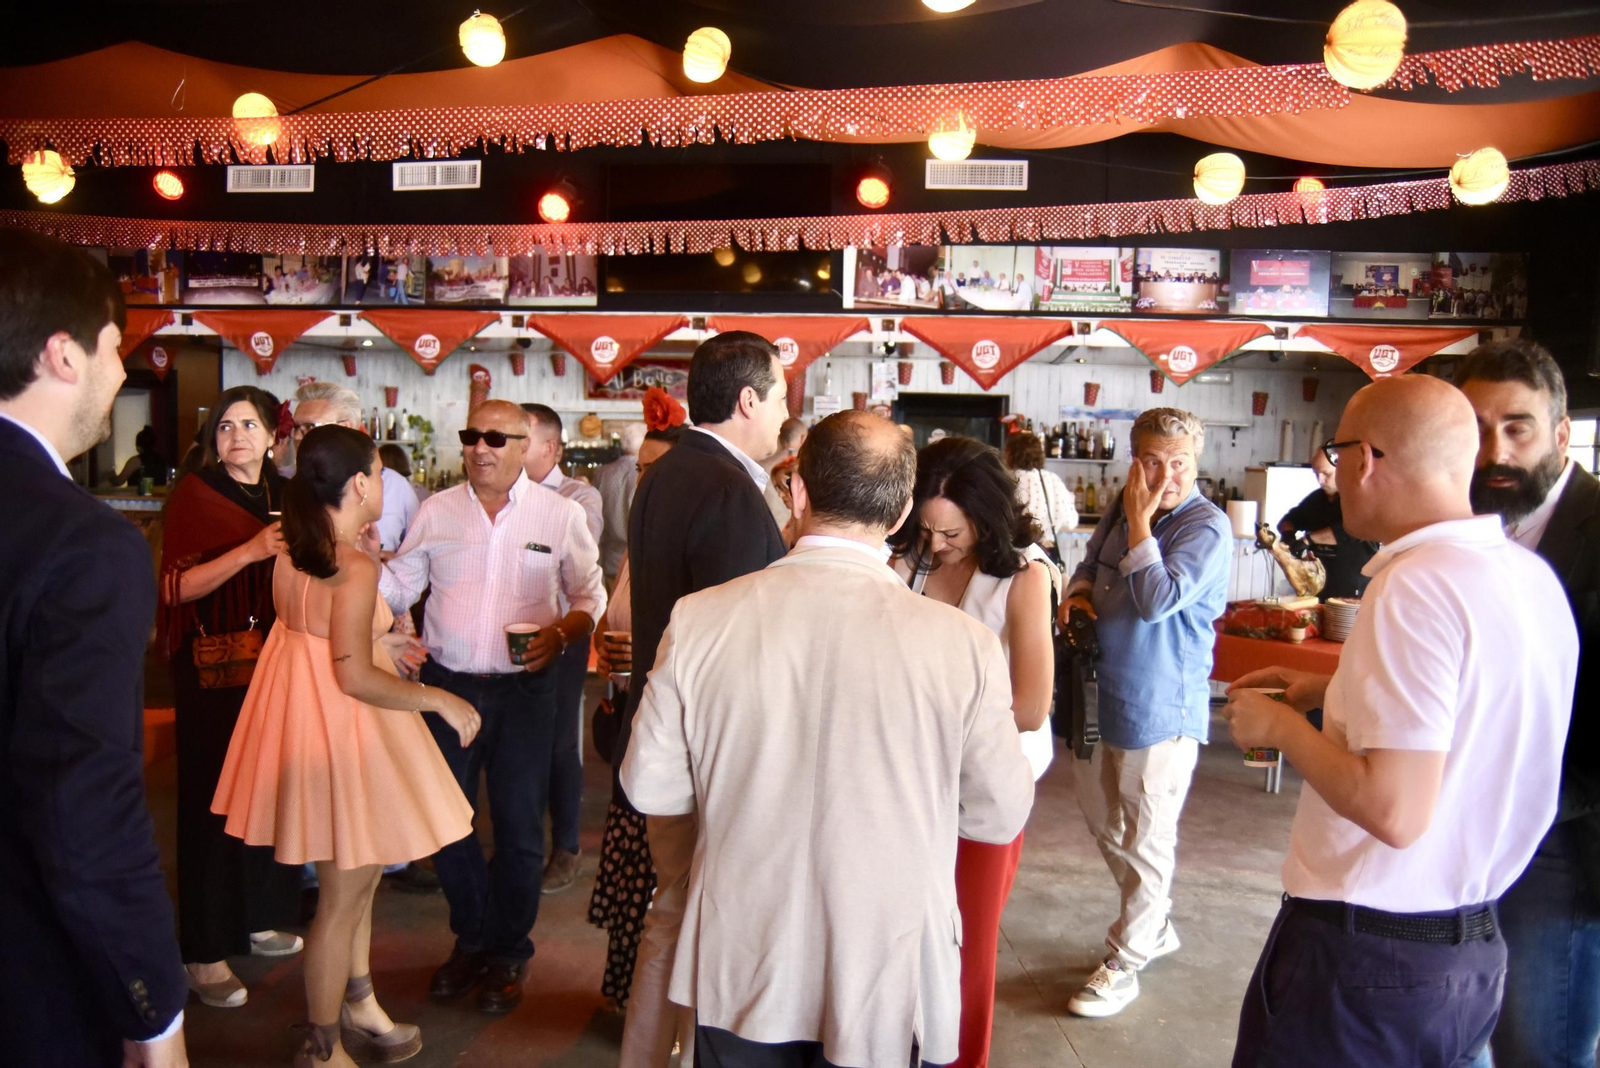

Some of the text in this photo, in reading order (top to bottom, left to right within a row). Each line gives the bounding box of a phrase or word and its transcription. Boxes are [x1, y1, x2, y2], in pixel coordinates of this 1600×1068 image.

[253, 335, 270, 347] UGT
[418, 338, 437, 349] UGT
[594, 340, 615, 351] UGT
[975, 344, 996, 357] UGT
[1172, 350, 1193, 363] UGT
[1373, 348, 1396, 360] UGT
